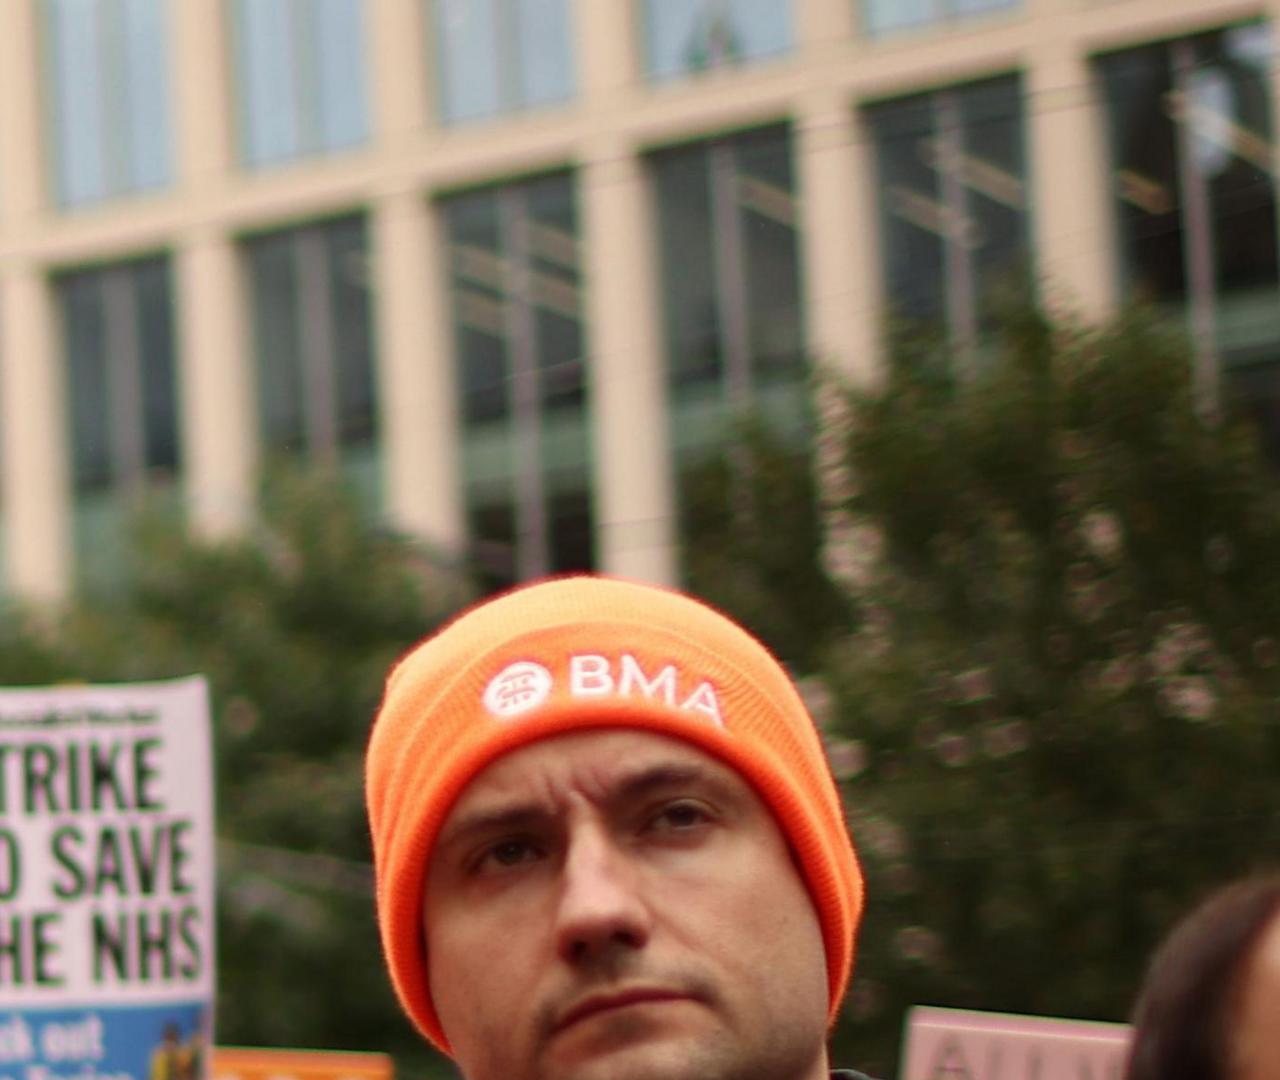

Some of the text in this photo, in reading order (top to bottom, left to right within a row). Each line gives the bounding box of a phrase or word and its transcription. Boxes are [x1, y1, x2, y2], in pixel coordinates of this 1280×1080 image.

[569, 653, 726, 728] BMA
[51, 820, 195, 900] SAVE
[93, 908, 201, 982] NHS
